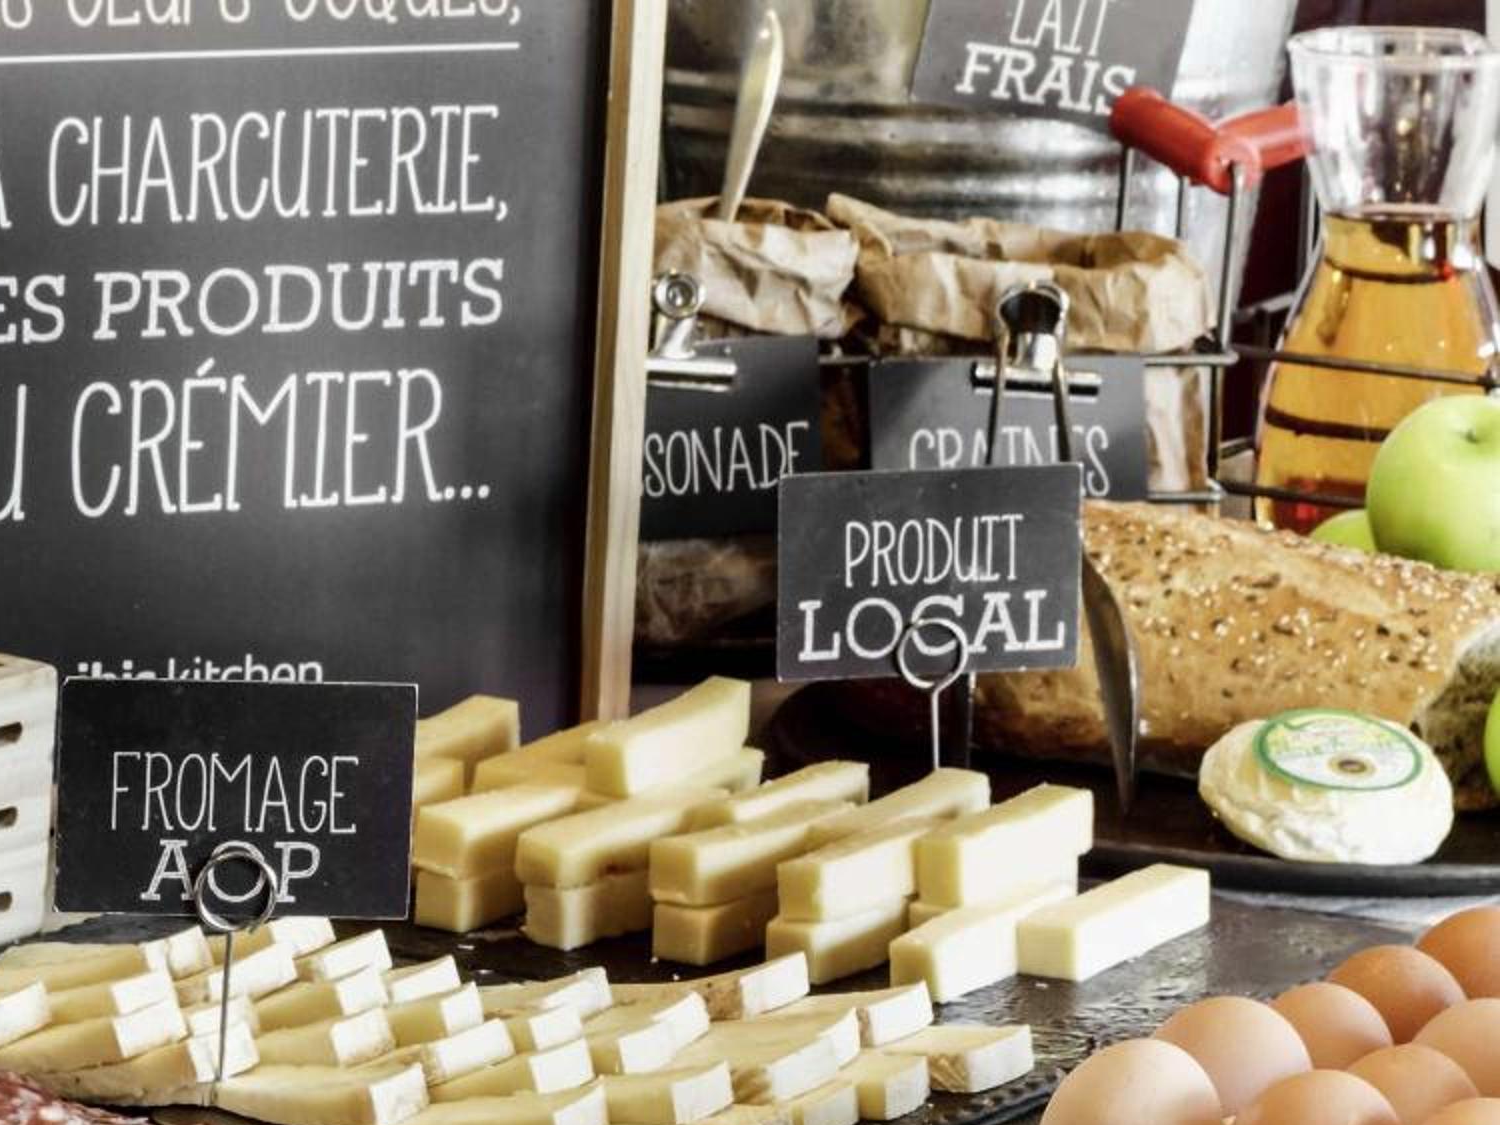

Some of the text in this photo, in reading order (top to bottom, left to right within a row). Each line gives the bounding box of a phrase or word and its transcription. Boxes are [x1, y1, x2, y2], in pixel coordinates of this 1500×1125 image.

[1009, 0, 1111, 56] LAIT
[954, 41, 1136, 116] FRAIS
[48, 104, 508, 226] CHARCUTERIE,
[93, 257, 504, 340] PRODUITS
[71, 357, 491, 518] CRÉMIER...
[845, 513, 1024, 588] PRODUIT
[798, 588, 1066, 662] LOCAL
[111, 751, 360, 834] FROMAGE
[139, 838, 321, 903] AOP
